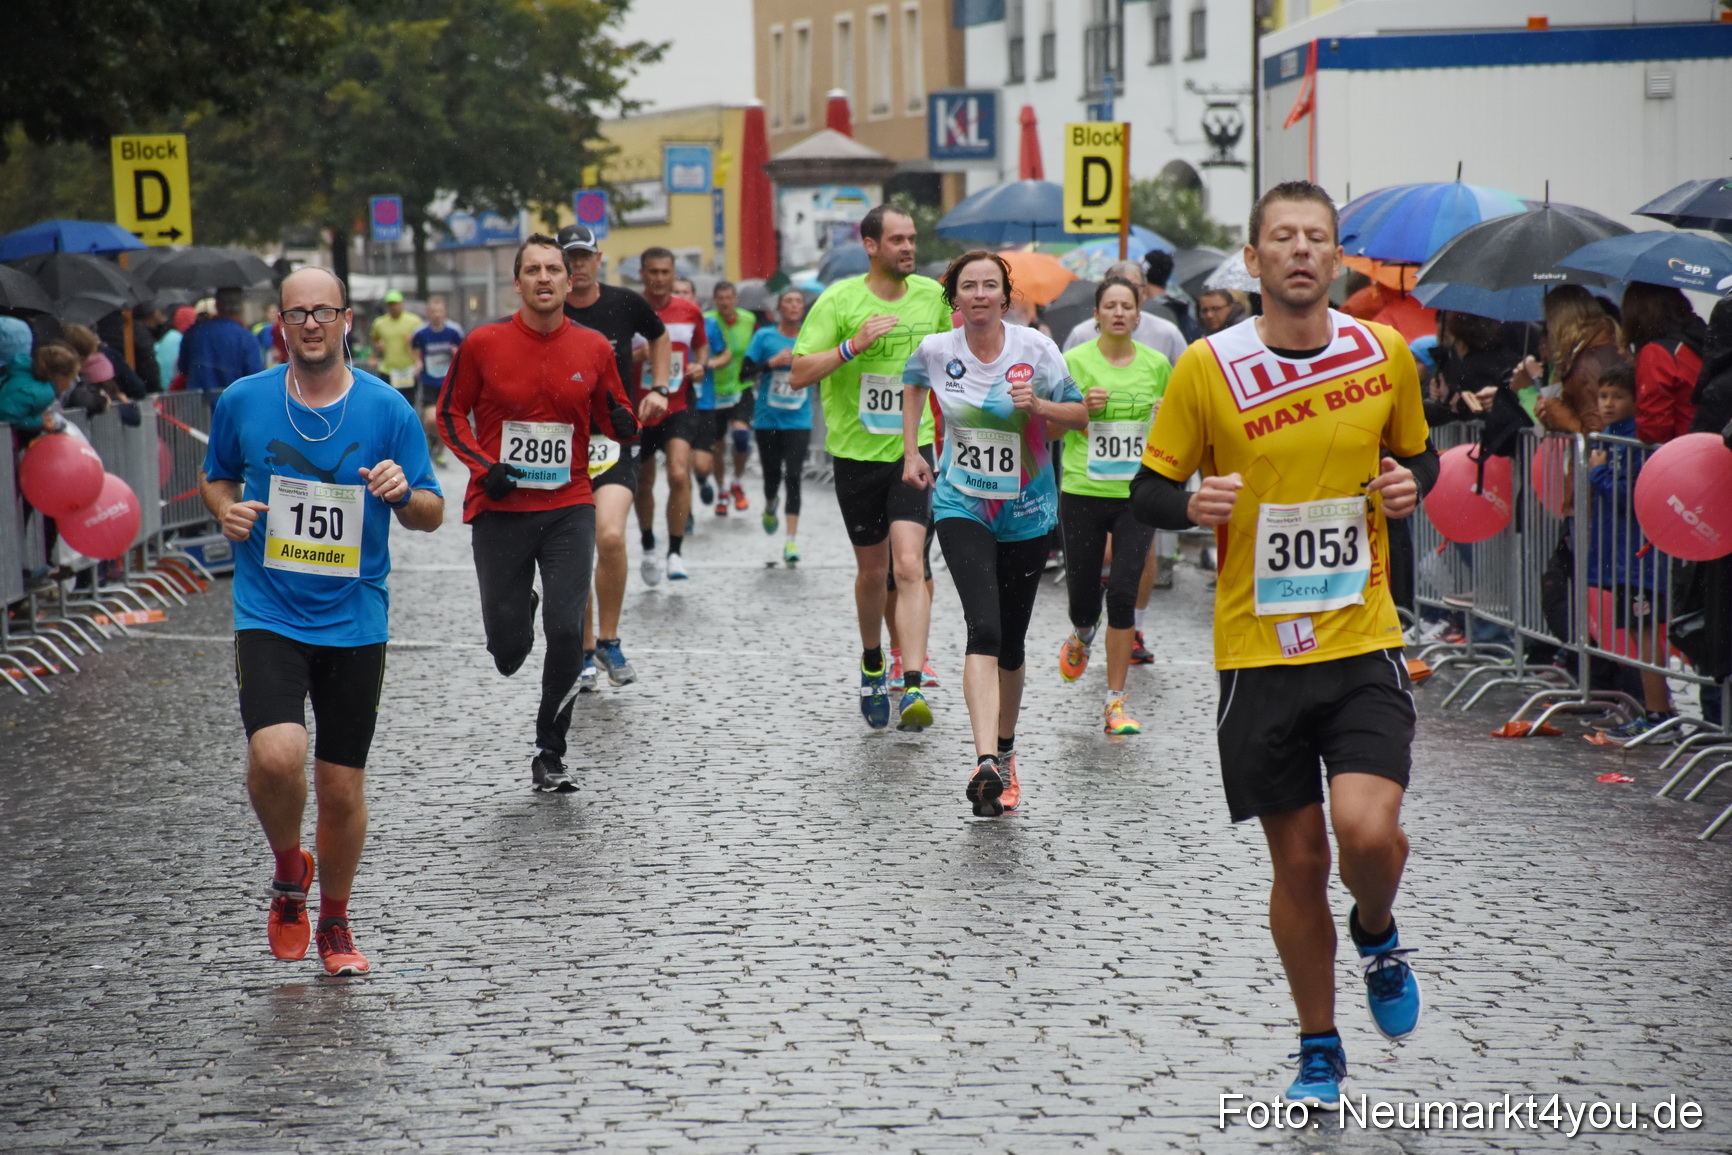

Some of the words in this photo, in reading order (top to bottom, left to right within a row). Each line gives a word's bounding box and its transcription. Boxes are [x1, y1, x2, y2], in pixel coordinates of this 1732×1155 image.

[1073, 127, 1123, 146] Block
[122, 140, 178, 160] Block
[1082, 156, 1113, 207] D
[134, 169, 171, 221] D
[1008, 369, 1031, 379] Hervis
[1243, 399, 1318, 441] MAX
[1323, 373, 1393, 412] BÖGL
[977, 431, 1014, 441] BOCK
[1095, 436, 1143, 457] 3015
[509, 437, 566, 464] 2896
[957, 441, 1014, 473] 2318
[314, 486, 356, 500] BOCK
[965, 475, 998, 490] Andrea
[290, 502, 344, 541] 150
[280, 543, 346, 564] Alexander
[1268, 526, 1359, 571] 3053
[1277, 579, 1329, 597] Bernd
